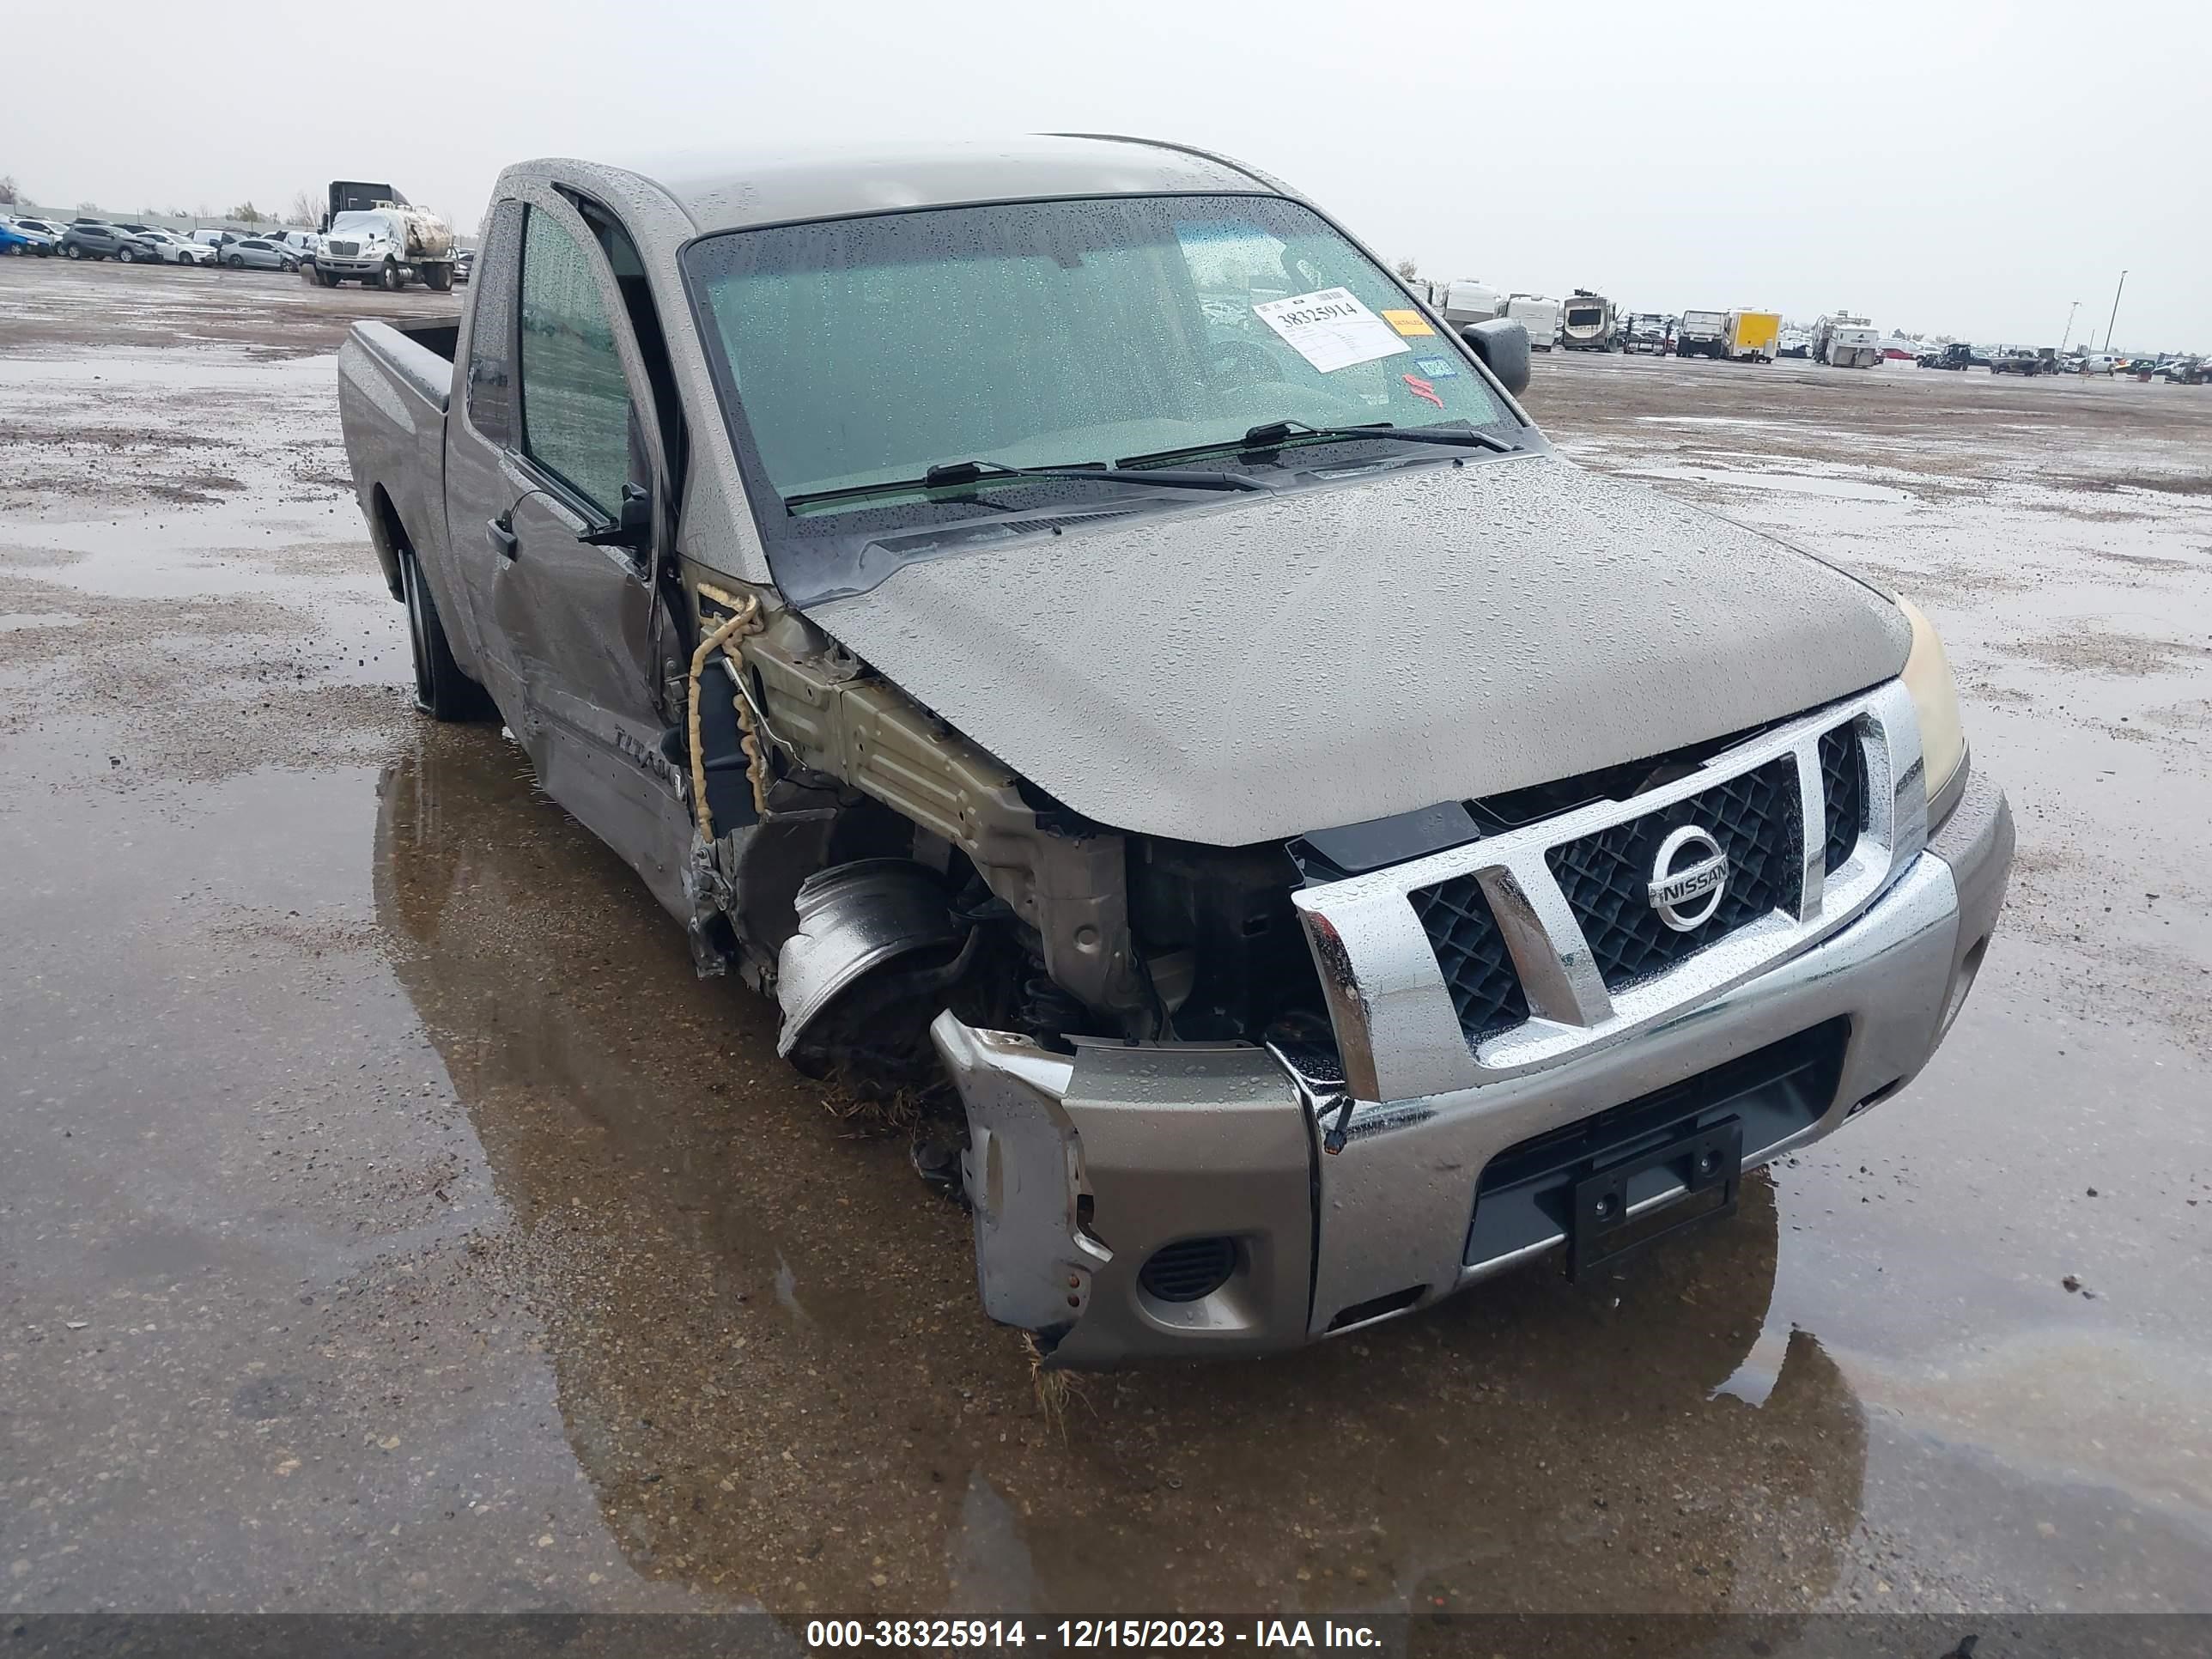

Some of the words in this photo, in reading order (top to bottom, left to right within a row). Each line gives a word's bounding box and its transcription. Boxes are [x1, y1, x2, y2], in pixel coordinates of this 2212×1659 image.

[1277, 302, 1358, 328] 38325914
[614, 723, 674, 788] TITAN
[1663, 860, 1728, 902] NISSAN
